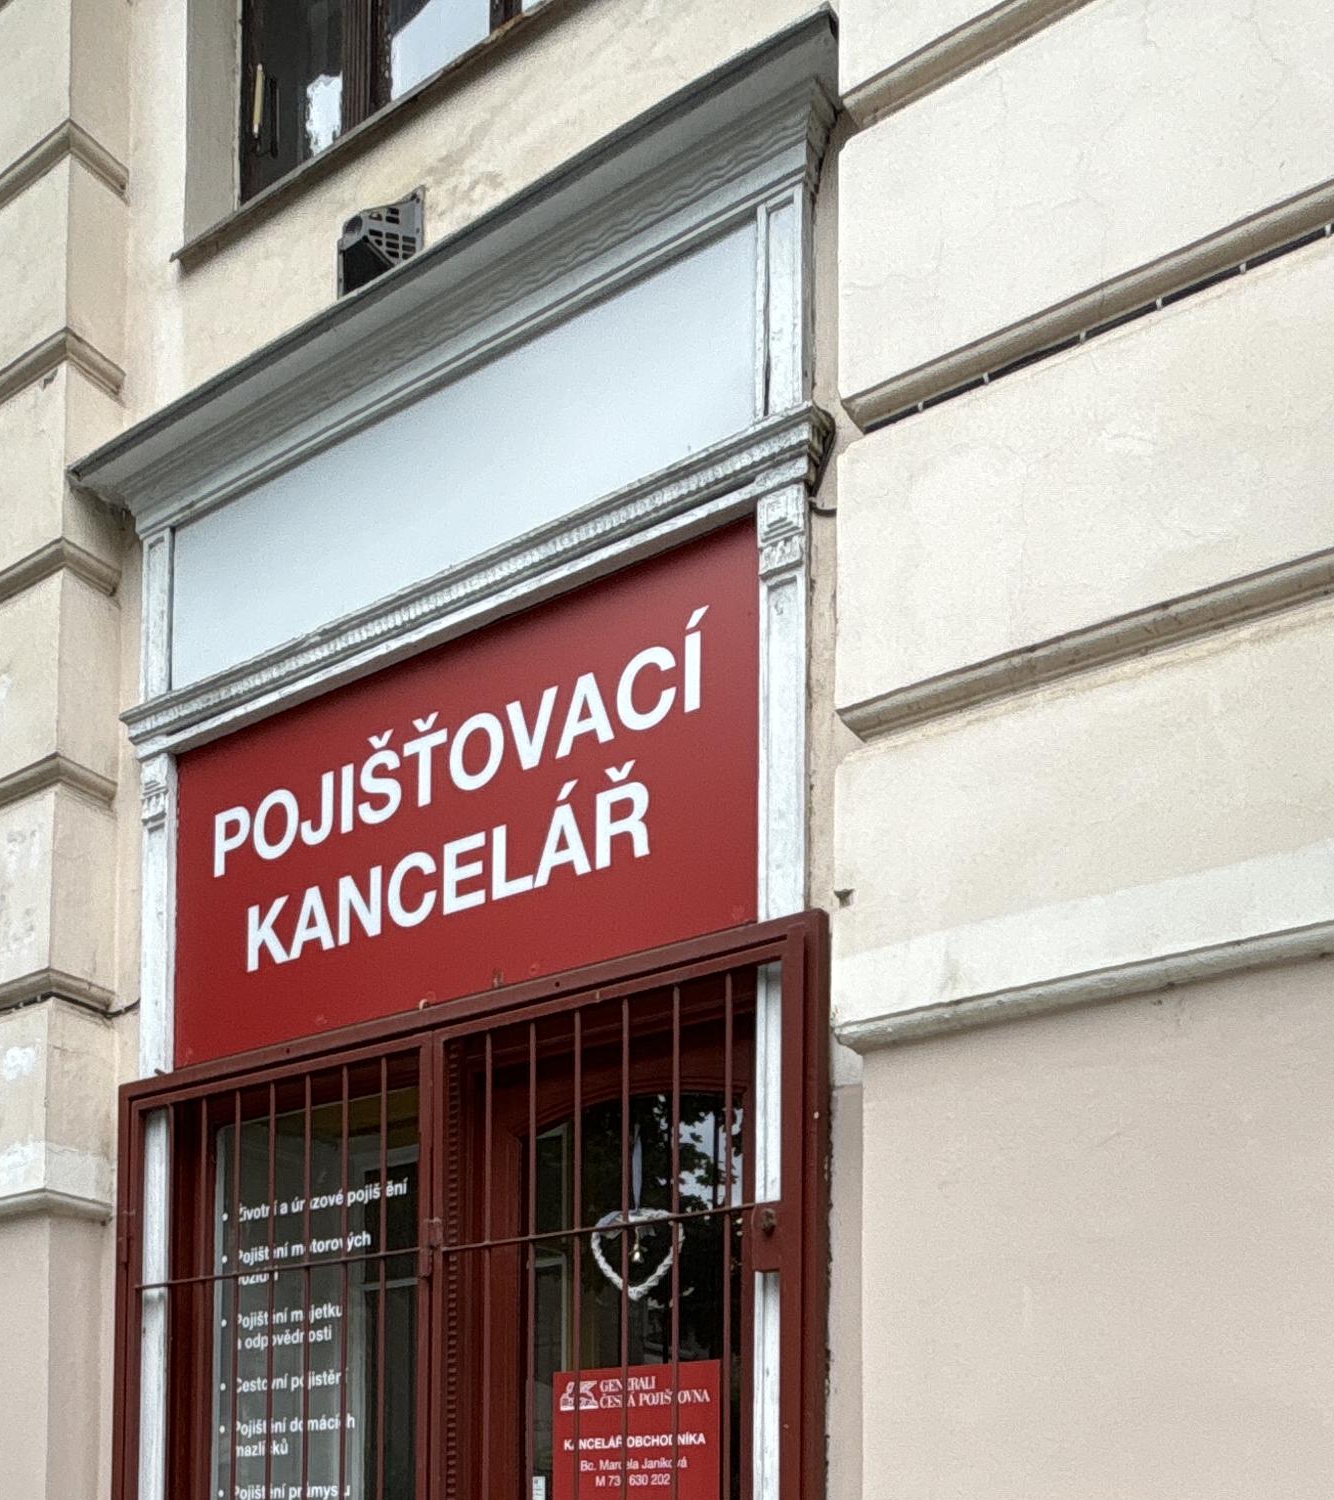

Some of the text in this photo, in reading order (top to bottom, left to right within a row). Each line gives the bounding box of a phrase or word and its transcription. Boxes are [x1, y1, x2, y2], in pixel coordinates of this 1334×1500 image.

[213, 605, 710, 878] POJIŠŤOVACÍ
[246, 759, 651, 973] KANCELÁŘ
[279, 1202, 288, 1215] a
[291, 1188, 344, 1214] úrzové
[347, 1177, 409, 1208] pojišění
[291, 1230, 372, 1257] mtoroých
[290, 1302, 343, 1324] mjetku
[599, 1388, 711, 1409] ČESÁ POJIŠOVNA
[289, 1412, 355, 1432] domácíh
[235, 1437, 289, 1457] mazlíků
[563, 1434, 623, 1451] KNCELÁŘ
[608, 1475, 624, 1487] 73
